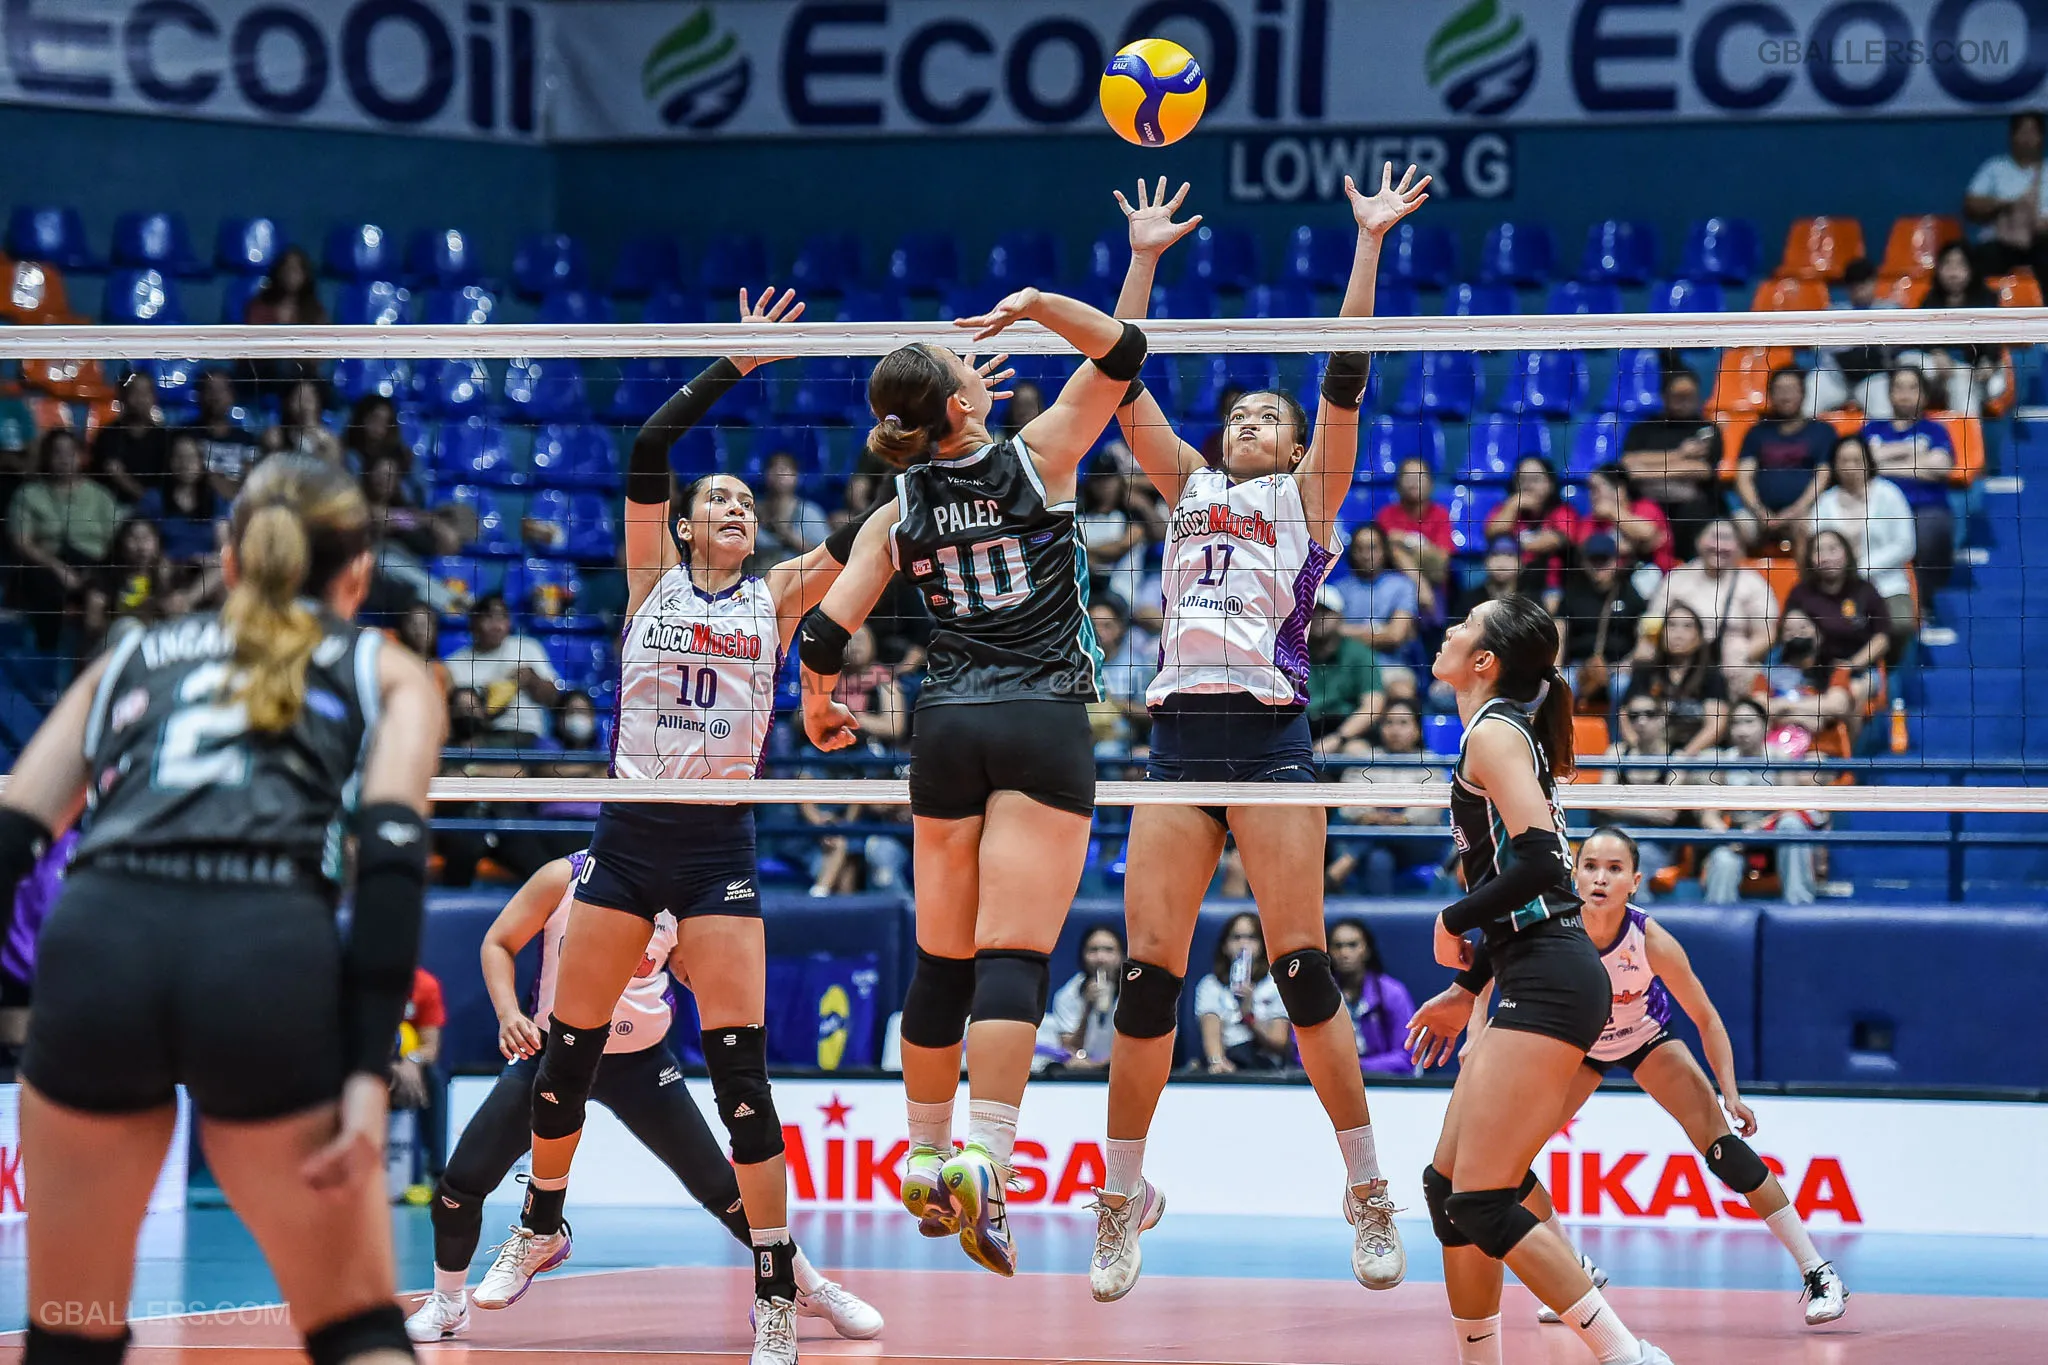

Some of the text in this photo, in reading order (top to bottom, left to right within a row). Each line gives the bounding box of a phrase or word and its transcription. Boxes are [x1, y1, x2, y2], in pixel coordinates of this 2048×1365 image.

[4, 0, 537, 133] EcoOil
[1229, 134, 1510, 199] LOWER G
[933, 500, 1002, 536] PALEC
[936, 537, 1034, 617] 10
[1197, 544, 1235, 586] 17
[1178, 596, 1224, 611] Allianz
[642, 617, 762, 661] ChocoMucho
[675, 664, 718, 709] 10
[656, 714, 706, 733] Allianz
[724, 892, 755, 901] BALANCE
[727, 888, 752, 896] WORLD
[734, 1109, 756, 1118] adidas
[783, 1124, 1107, 1205] IKSA
